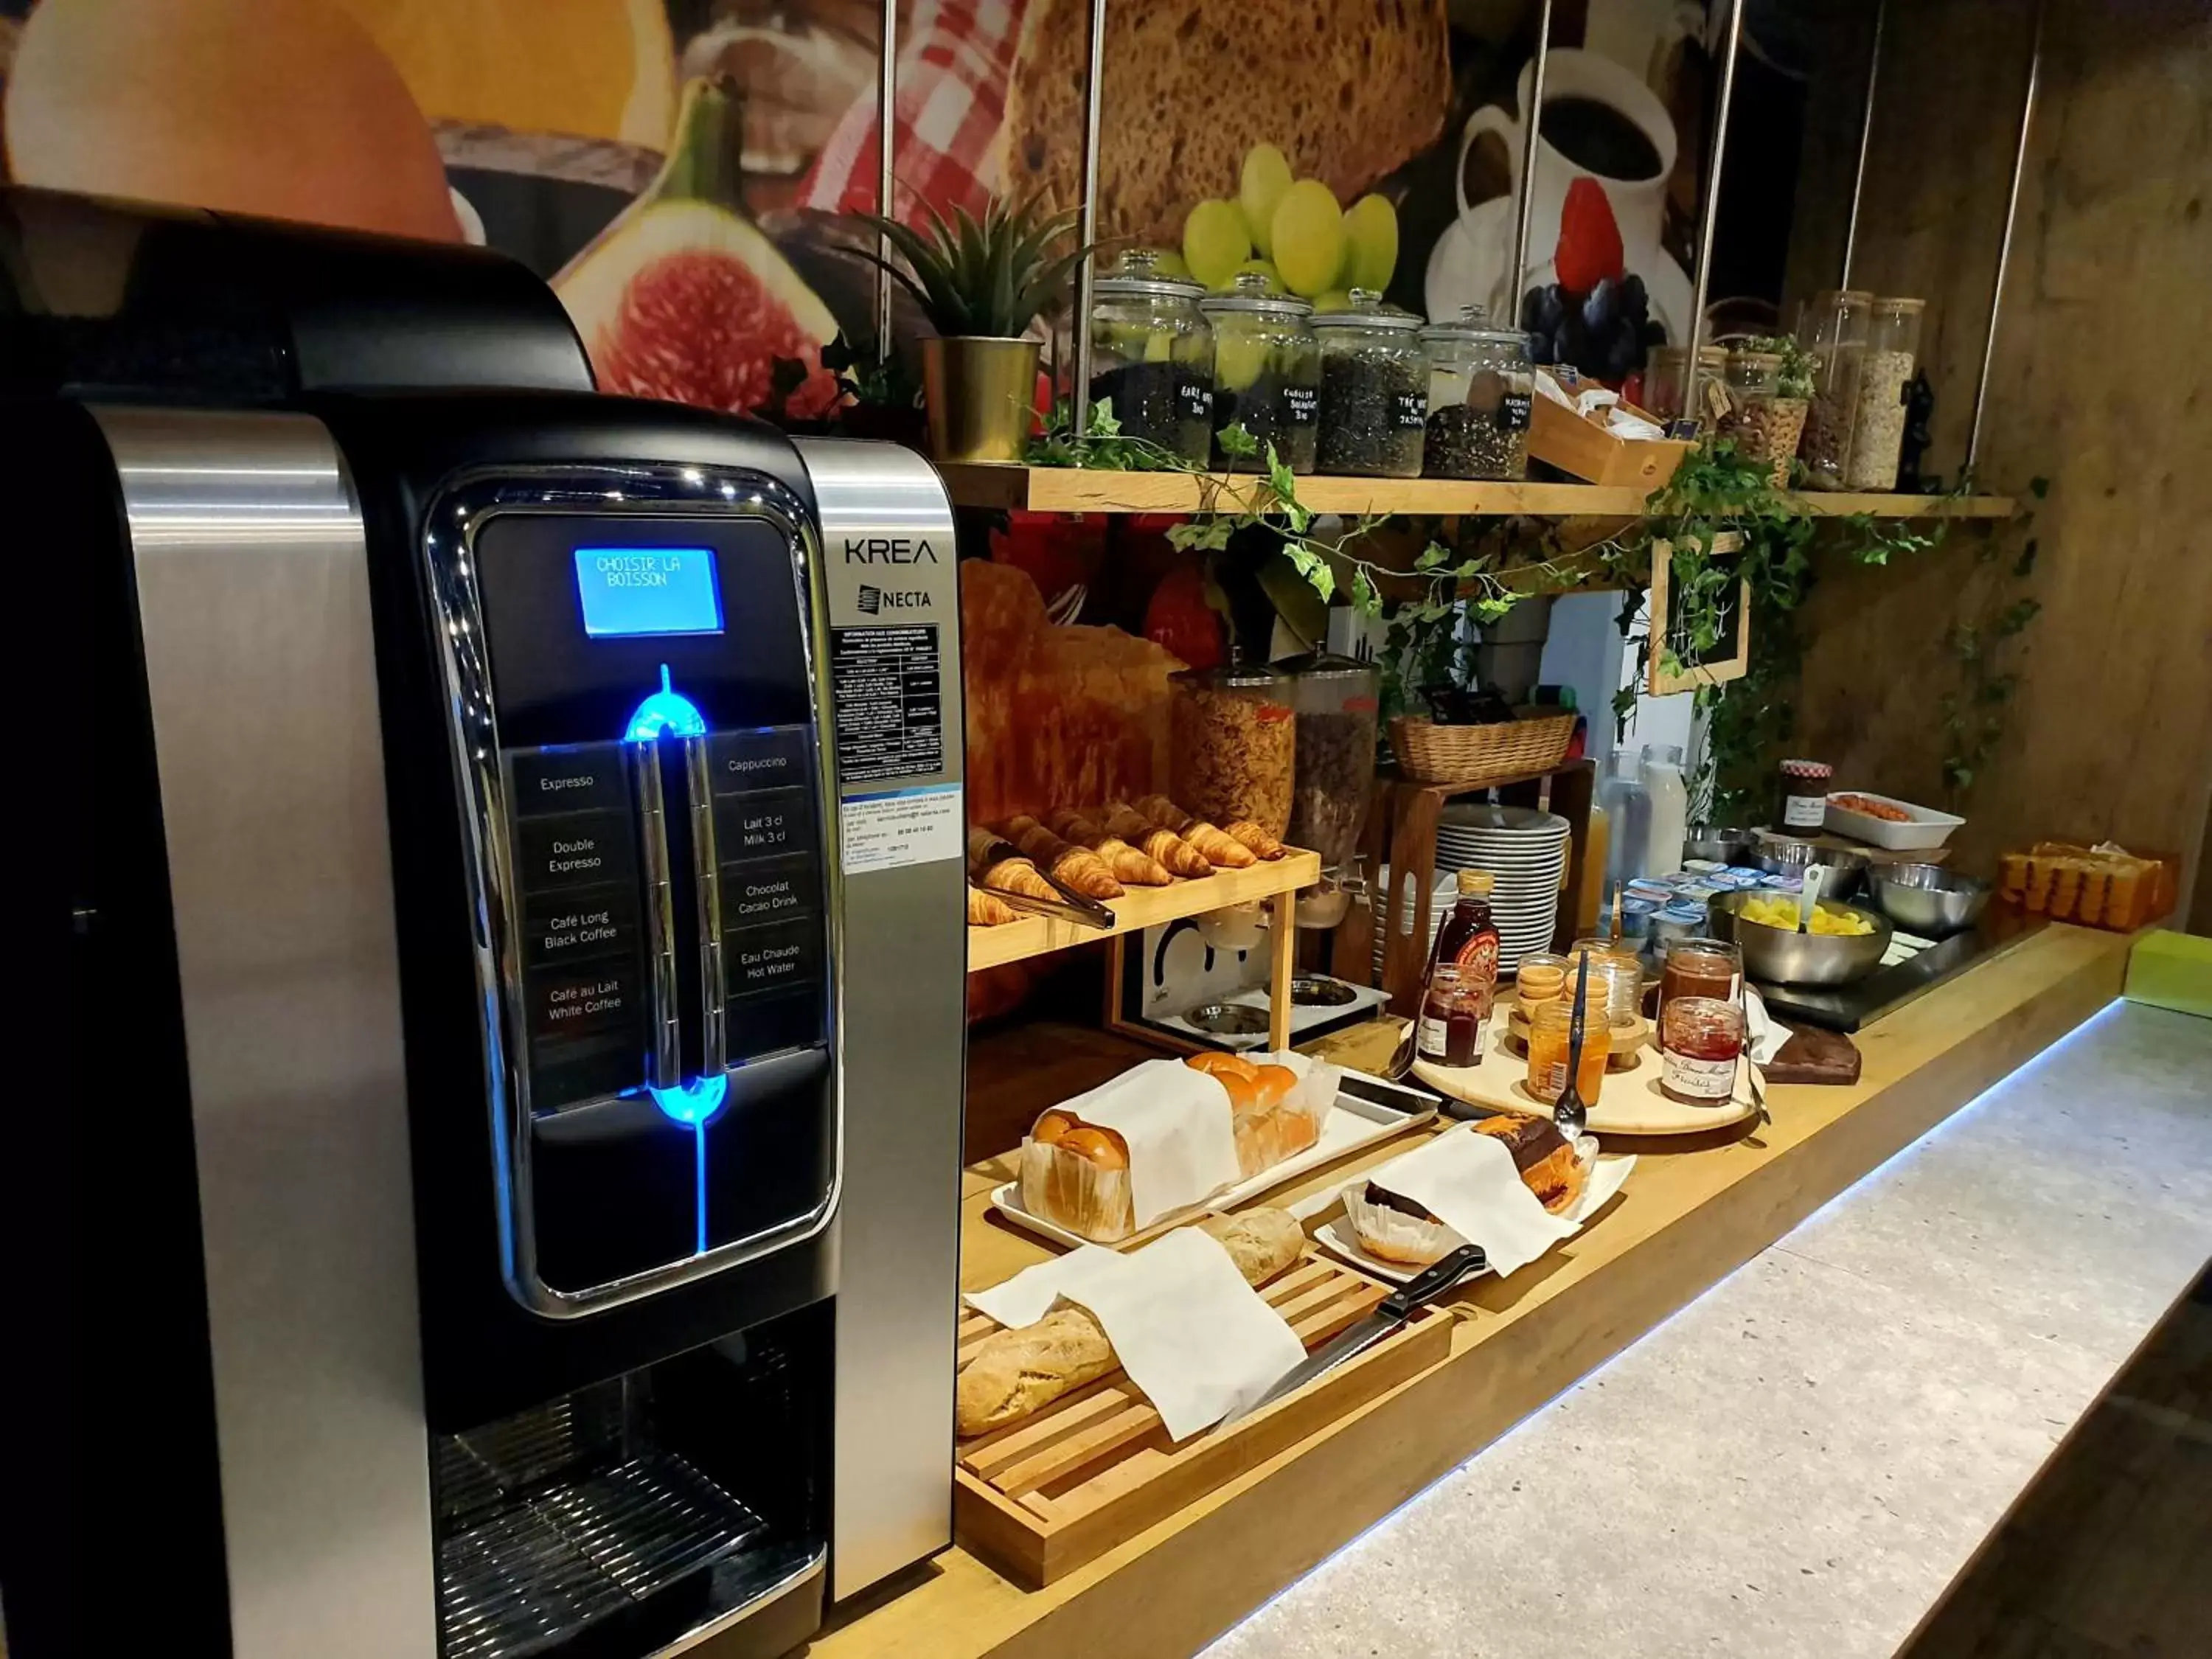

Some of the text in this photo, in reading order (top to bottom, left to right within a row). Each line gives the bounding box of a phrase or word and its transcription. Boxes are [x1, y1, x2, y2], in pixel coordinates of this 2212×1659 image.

[845, 539, 938, 564] KREA
[597, 557, 681, 572] CHOISIR LA
[607, 572, 667, 587] BOISSON
[883, 591, 931, 608] NECTA
[728, 757, 787, 772] Cappuccino
[540, 776, 594, 790] Expresso
[744, 817, 762, 830] Lait
[765, 817, 773, 827] 3
[554, 839, 595, 853] Double
[744, 831, 785, 846] Milk 3 cl
[549, 858, 601, 872] Expresso
[745, 881, 789, 897] Chocolat
[739, 895, 798, 914] Cacao Drink
[551, 911, 609, 930] Café Long
[545, 927, 617, 949] Black Coffee
[741, 945, 800, 964] Eau Chaude
[747, 962, 795, 978] Hot Water
[551, 980, 619, 1002] Café au Lait
[549, 998, 622, 1020] White Coffee
